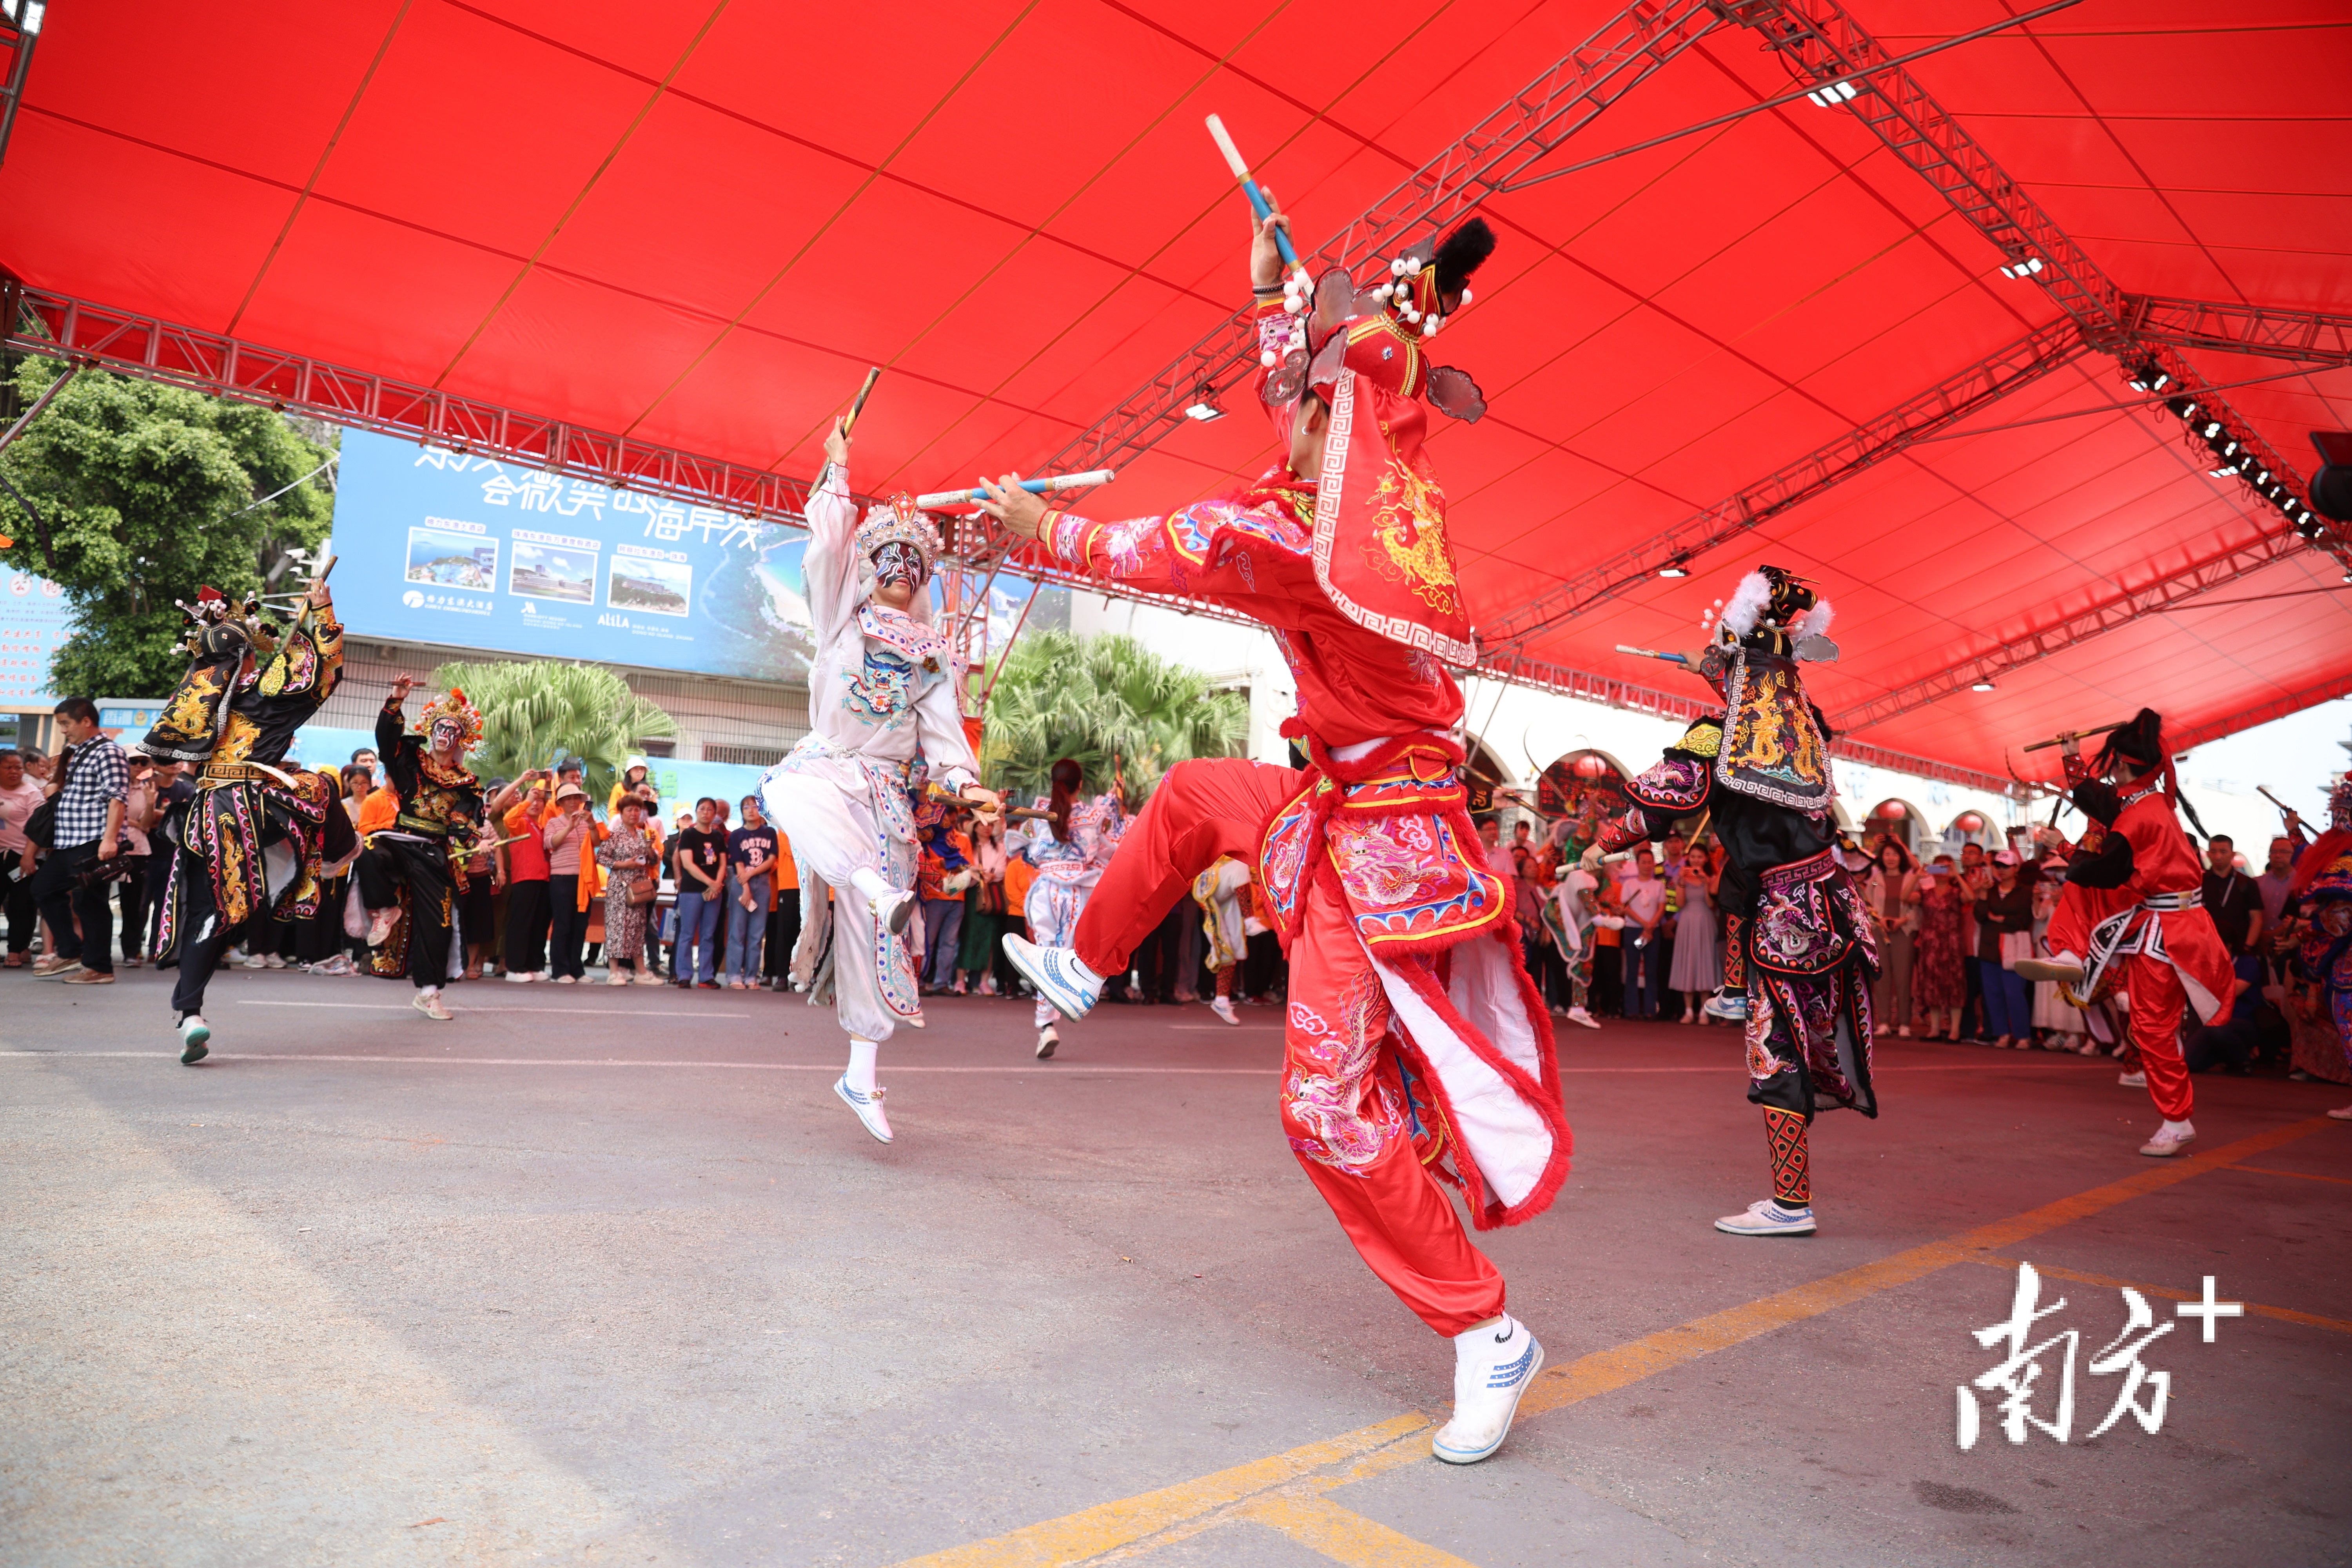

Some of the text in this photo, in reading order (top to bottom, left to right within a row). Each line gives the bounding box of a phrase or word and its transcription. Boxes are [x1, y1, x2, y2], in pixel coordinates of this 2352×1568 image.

[426, 518, 484, 533] 格力东澳大酒店
[513, 530, 600, 549] 珠海东澳岛万豪度假酒店
